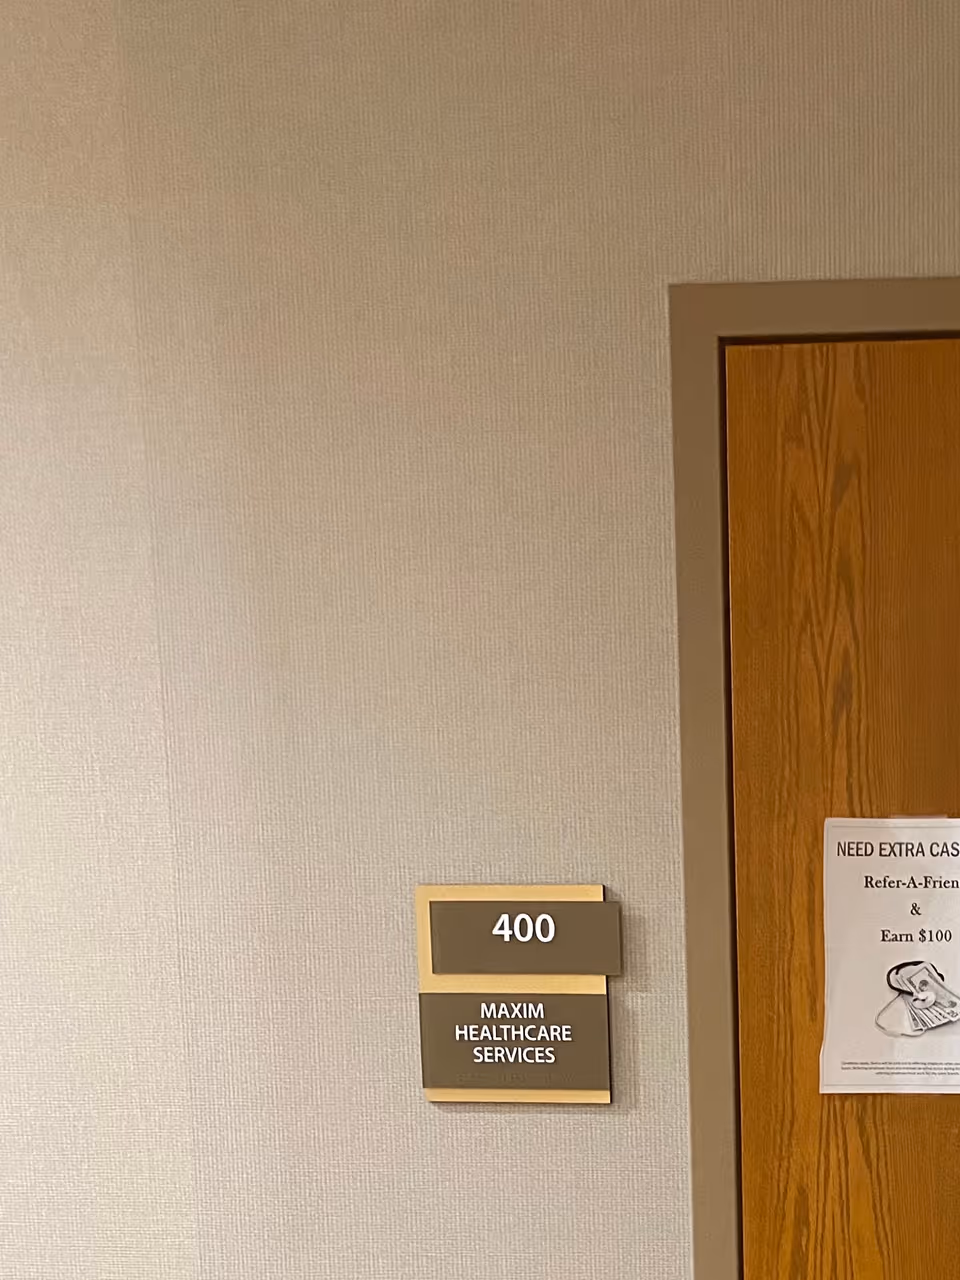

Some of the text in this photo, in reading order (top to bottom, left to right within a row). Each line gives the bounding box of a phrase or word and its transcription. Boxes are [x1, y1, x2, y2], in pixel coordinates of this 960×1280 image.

[837, 841, 874, 856] NEED
[879, 842, 925, 857] EXTRA
[910, 903, 922, 915] &
[492, 913, 556, 943] 400
[880, 930, 952, 942] Earn $100
[480, 1002, 544, 1018] MAXIM
[455, 1024, 572, 1041] HEALTHCARE
[473, 1046, 556, 1063] SERVICES
